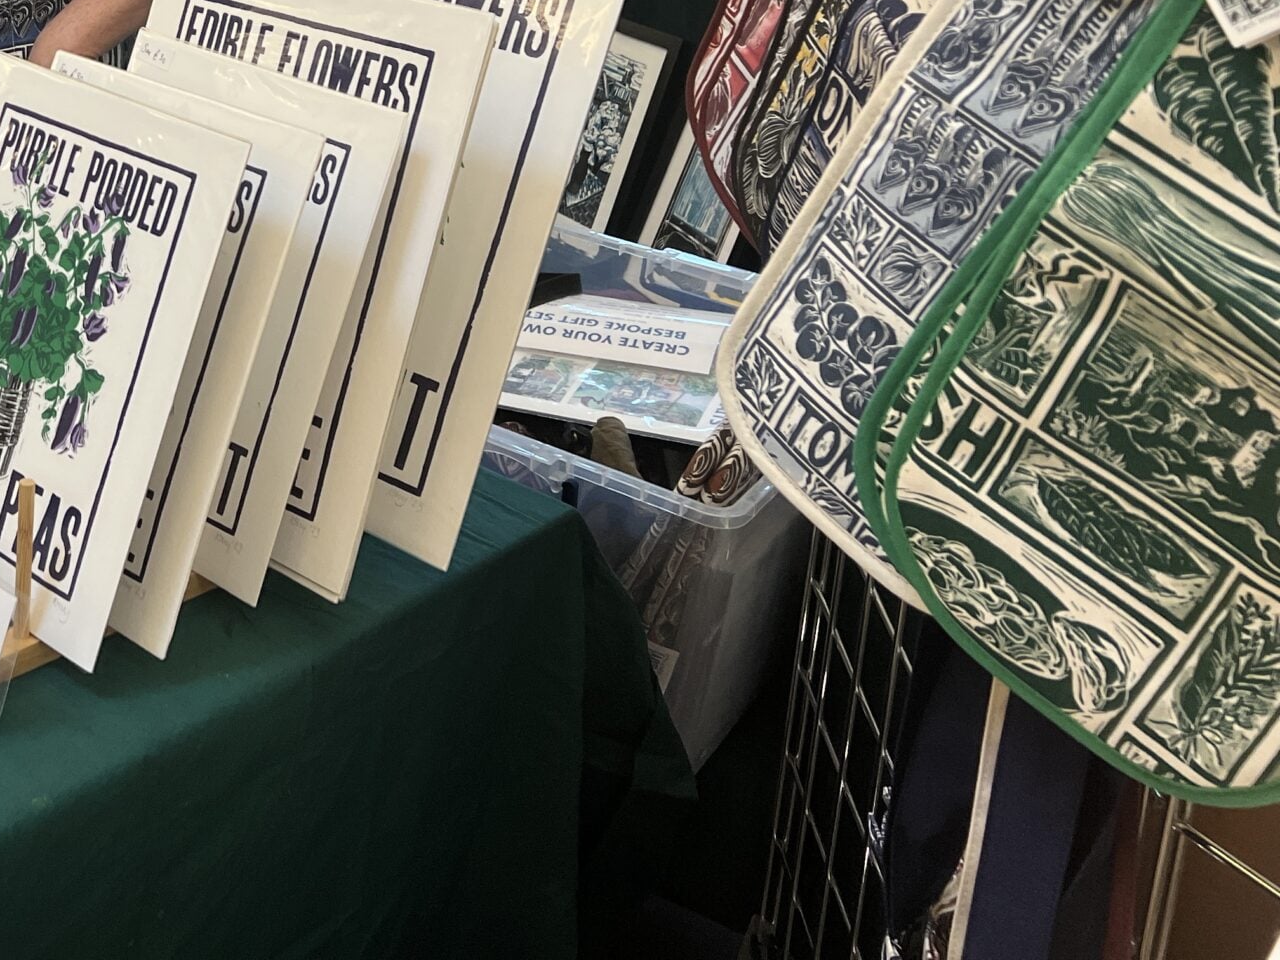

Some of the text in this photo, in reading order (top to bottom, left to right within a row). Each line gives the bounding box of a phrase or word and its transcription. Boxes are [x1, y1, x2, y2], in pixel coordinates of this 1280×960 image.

[80, 146, 179, 238] PODDED
[559, 314, 687, 340] BESPOKE GIFT
[562, 328, 690, 357] CREATE YOUR
